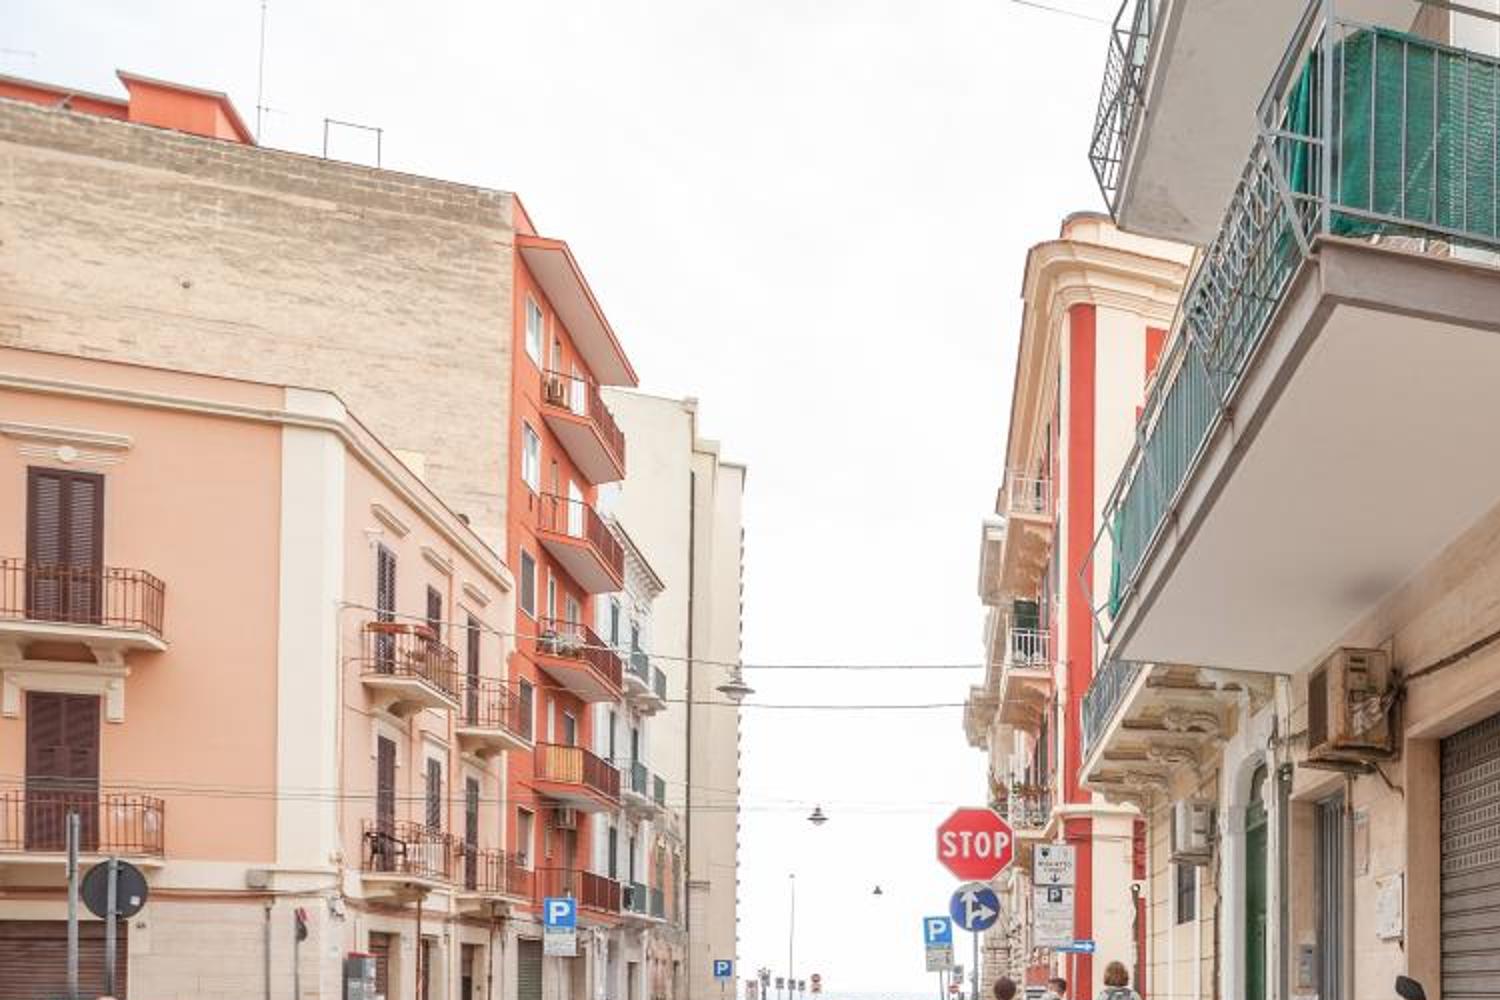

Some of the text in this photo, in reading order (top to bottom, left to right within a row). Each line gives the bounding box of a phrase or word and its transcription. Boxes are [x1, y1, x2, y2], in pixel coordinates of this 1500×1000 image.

[941, 831, 1010, 858] STOP
[549, 901, 570, 925] P
[929, 919, 947, 941] P
[717, 961, 729, 975] P
